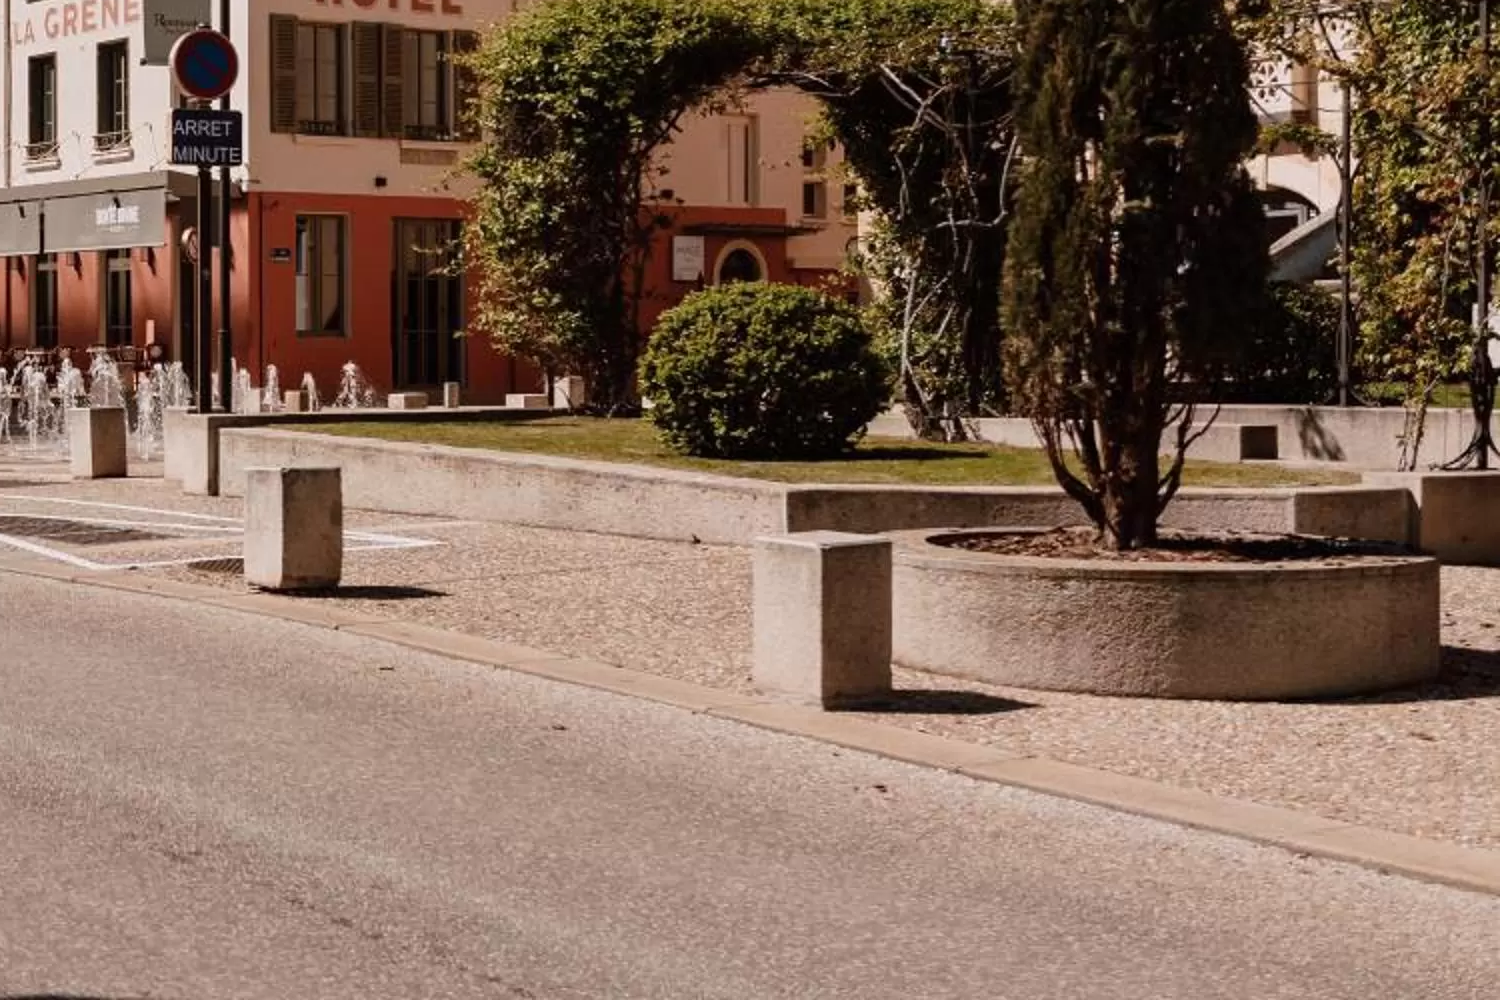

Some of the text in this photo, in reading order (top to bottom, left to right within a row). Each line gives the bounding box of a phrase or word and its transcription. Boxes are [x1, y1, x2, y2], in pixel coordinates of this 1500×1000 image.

[13, 18, 36, 47] LA
[173, 119, 233, 137] ARRET
[173, 145, 241, 164] MINUTE
